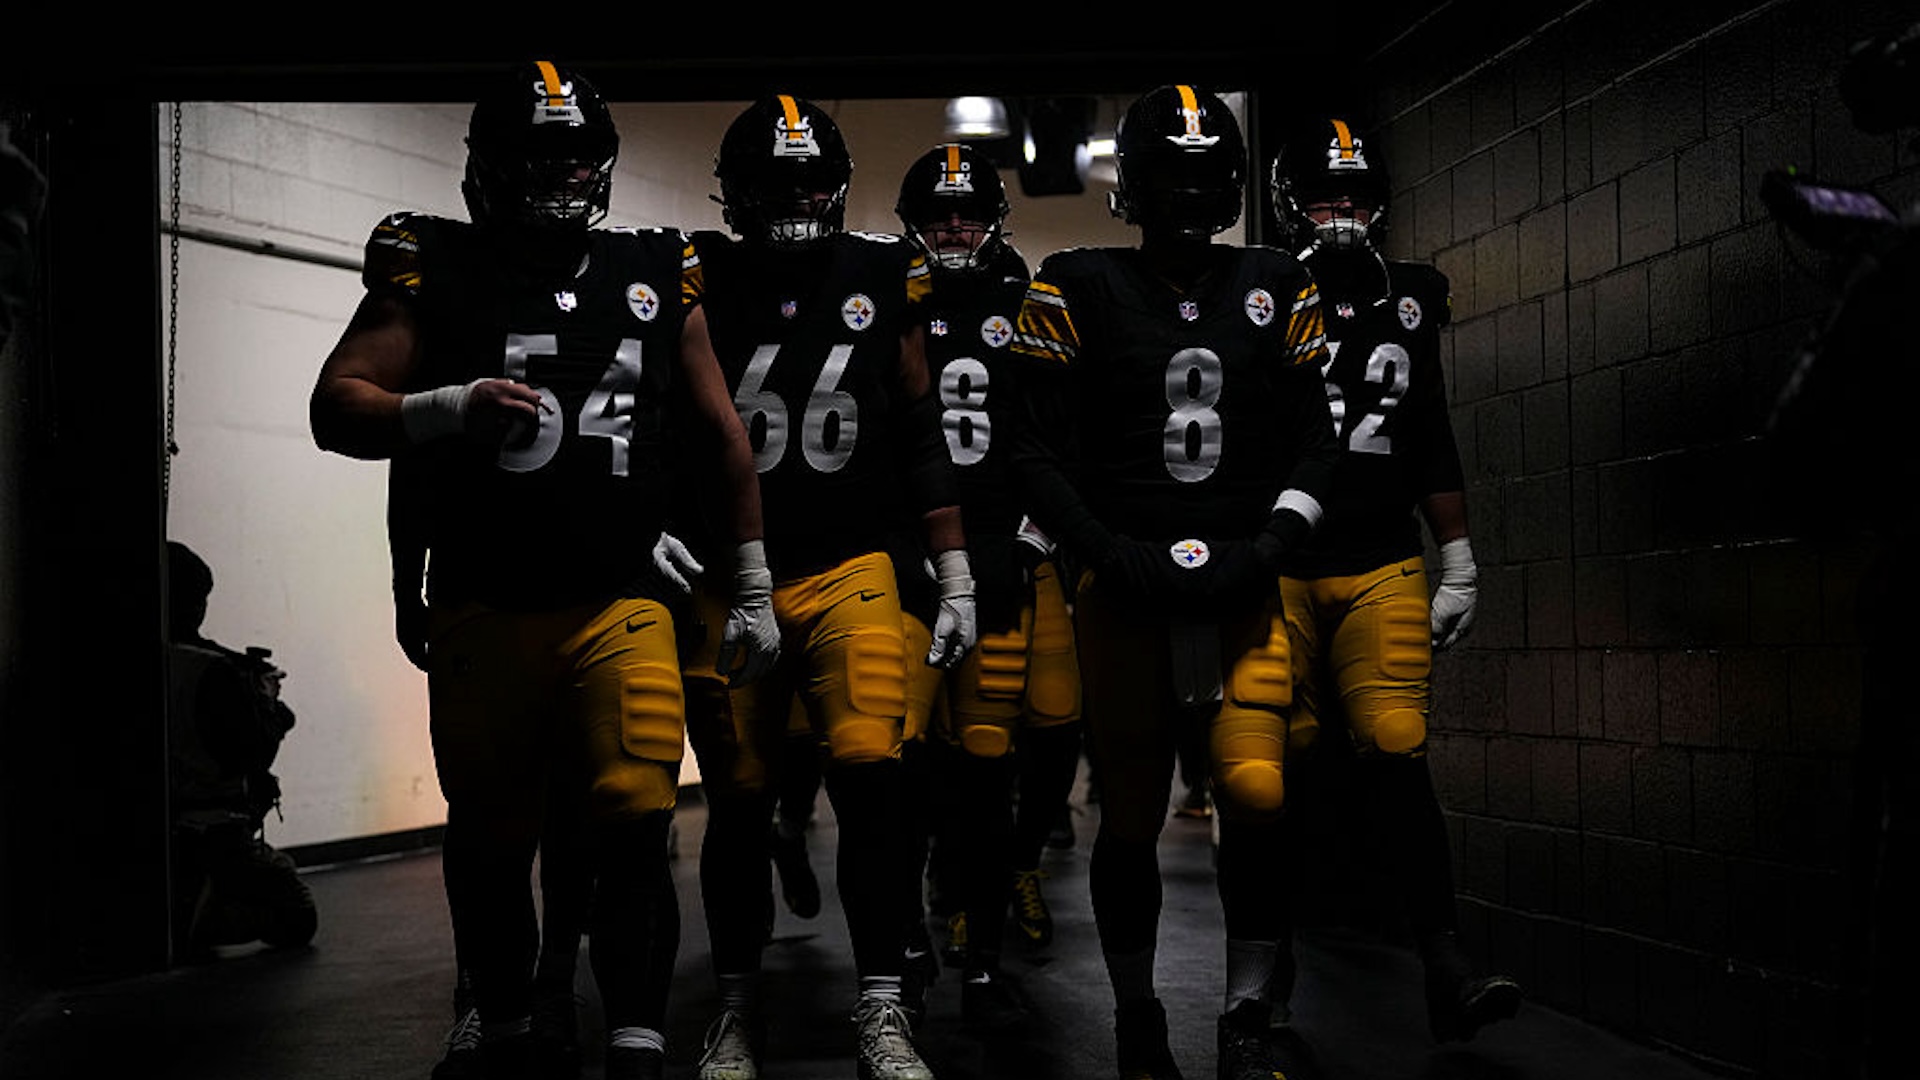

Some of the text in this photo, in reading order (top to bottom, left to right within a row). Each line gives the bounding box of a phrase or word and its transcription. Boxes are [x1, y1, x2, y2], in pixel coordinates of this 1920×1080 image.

[497, 332, 643, 477] 54
[734, 343, 859, 474] 66
[938, 356, 992, 466] 8
[1163, 347, 1223, 483] 8
